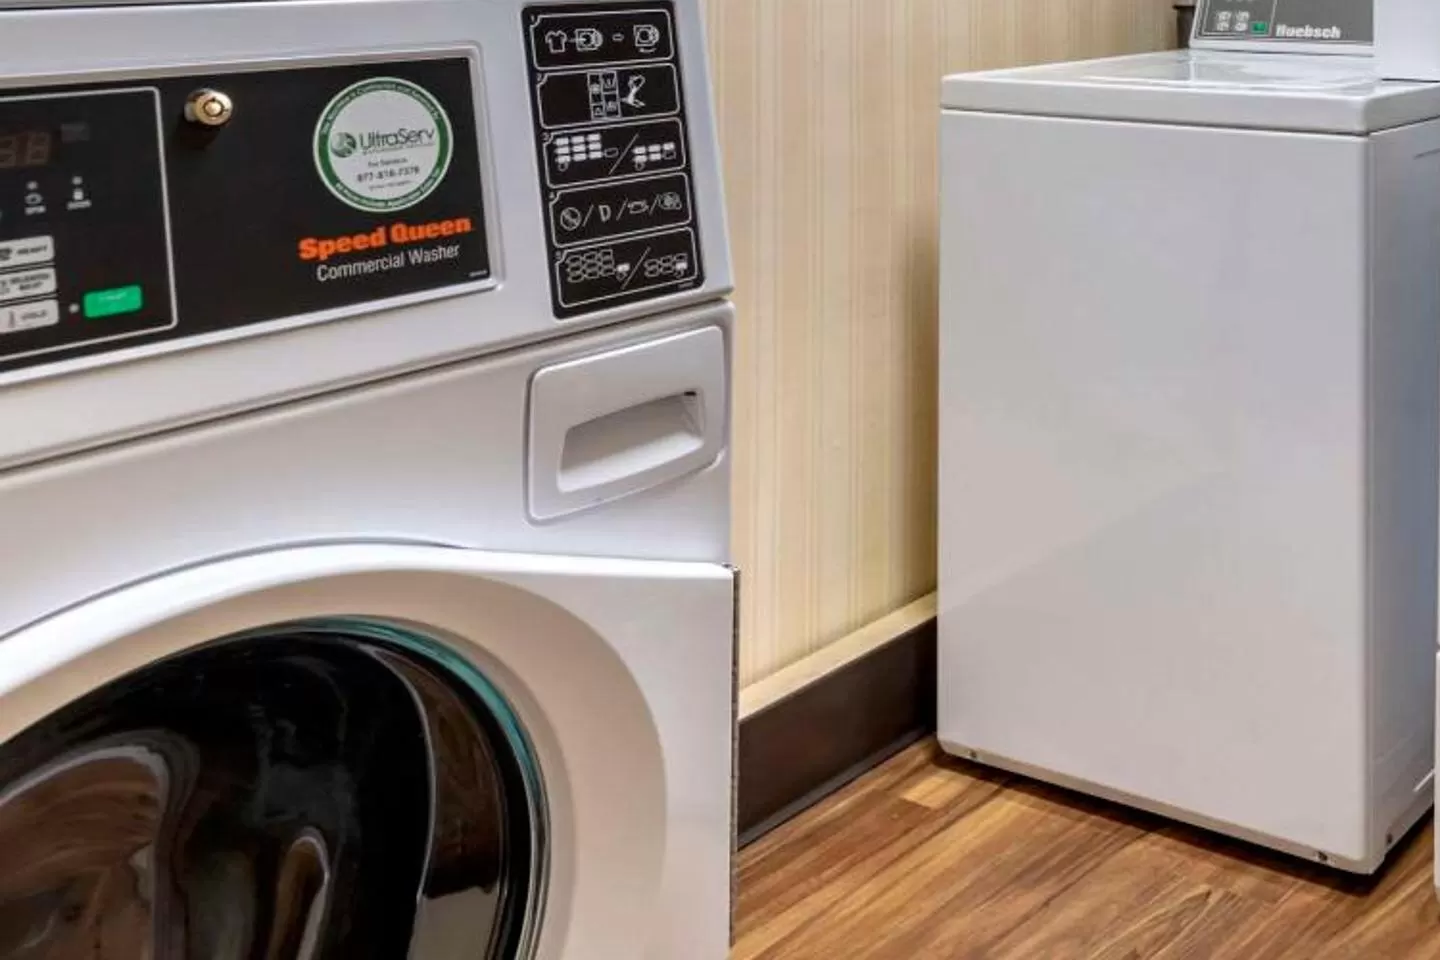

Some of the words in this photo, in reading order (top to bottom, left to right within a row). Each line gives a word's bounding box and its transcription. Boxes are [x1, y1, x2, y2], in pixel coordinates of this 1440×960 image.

[1275, 24, 1341, 38] Huebsch
[359, 127, 435, 150] UltraServ
[297, 225, 387, 261] Speed
[390, 216, 472, 243] Queen
[316, 250, 405, 282] Commercial
[408, 243, 460, 266] Washer
